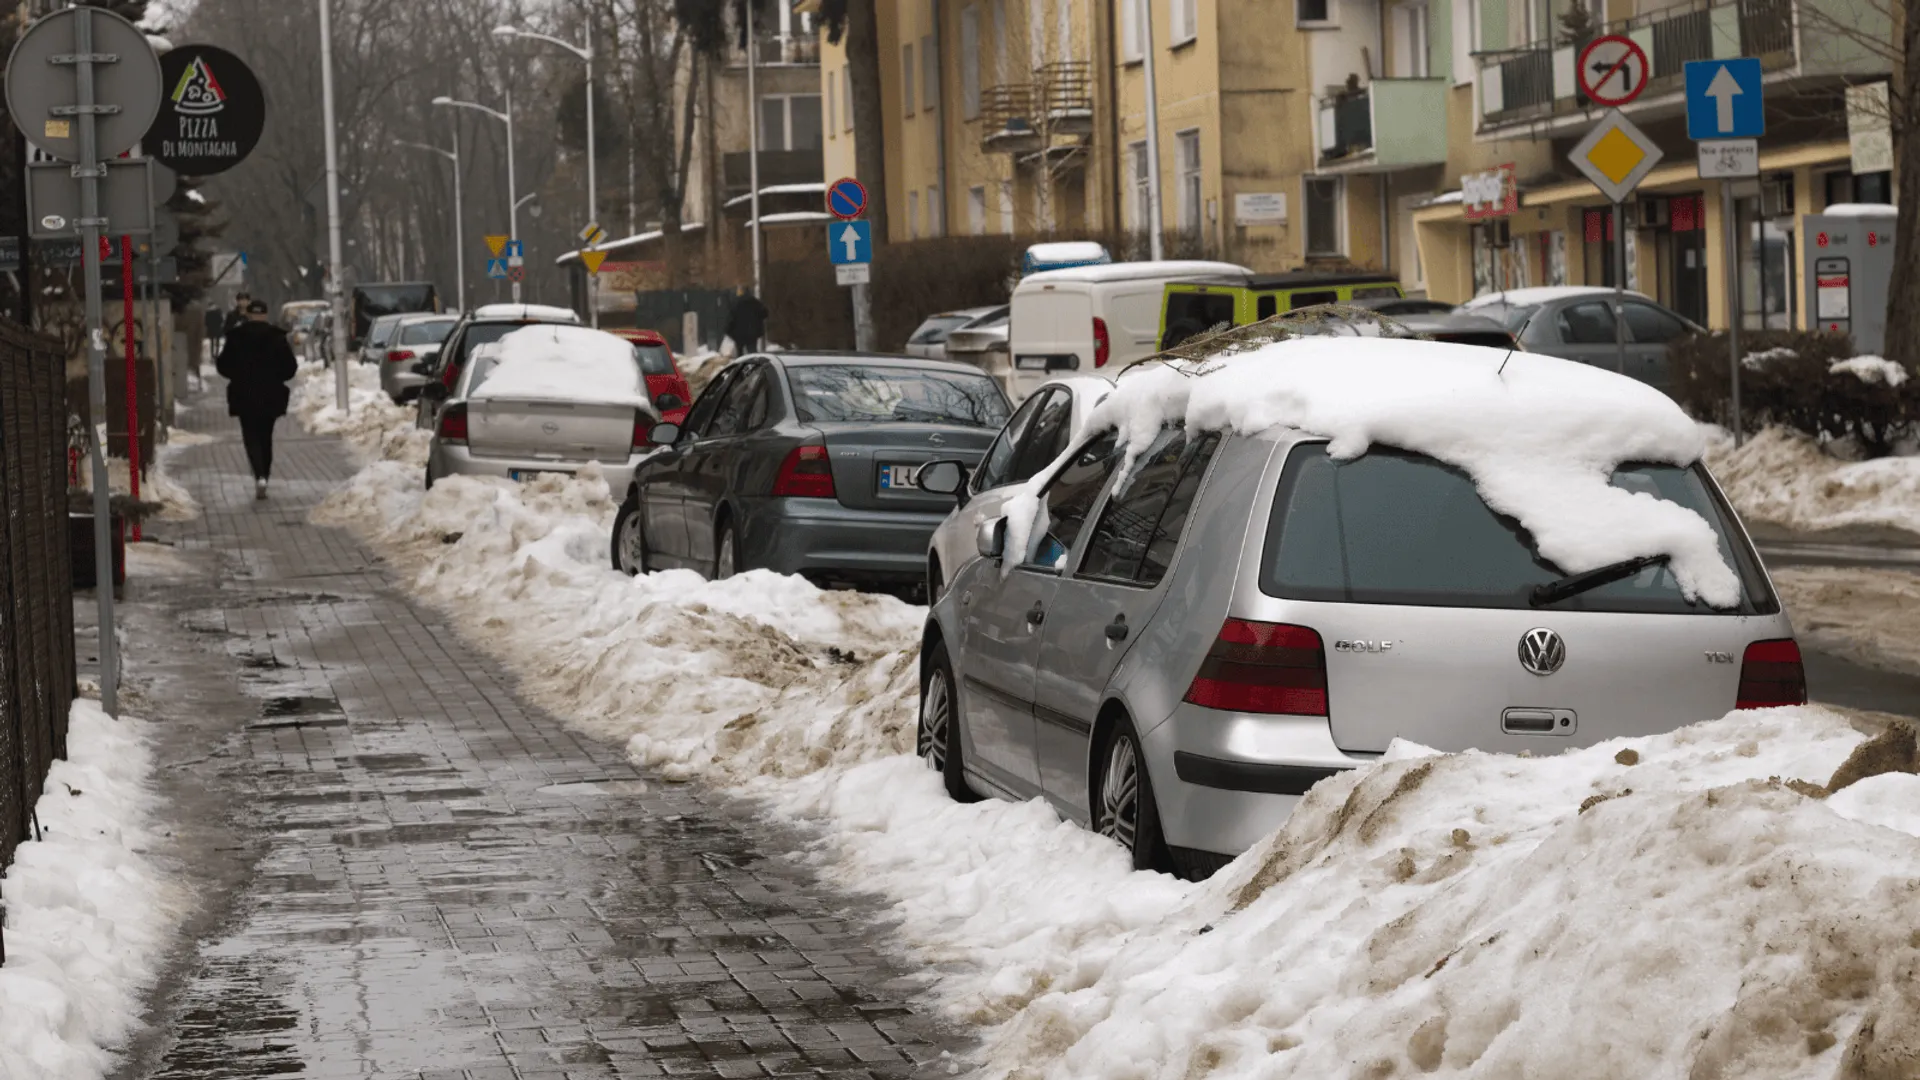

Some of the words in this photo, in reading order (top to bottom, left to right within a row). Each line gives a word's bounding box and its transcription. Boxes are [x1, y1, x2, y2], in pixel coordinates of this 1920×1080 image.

[179, 116, 219, 138] PIZZA
[178, 140, 237, 157] MONTAGNA
[1335, 639, 1392, 653] GOLF
[1704, 650, 1734, 664] TDI
